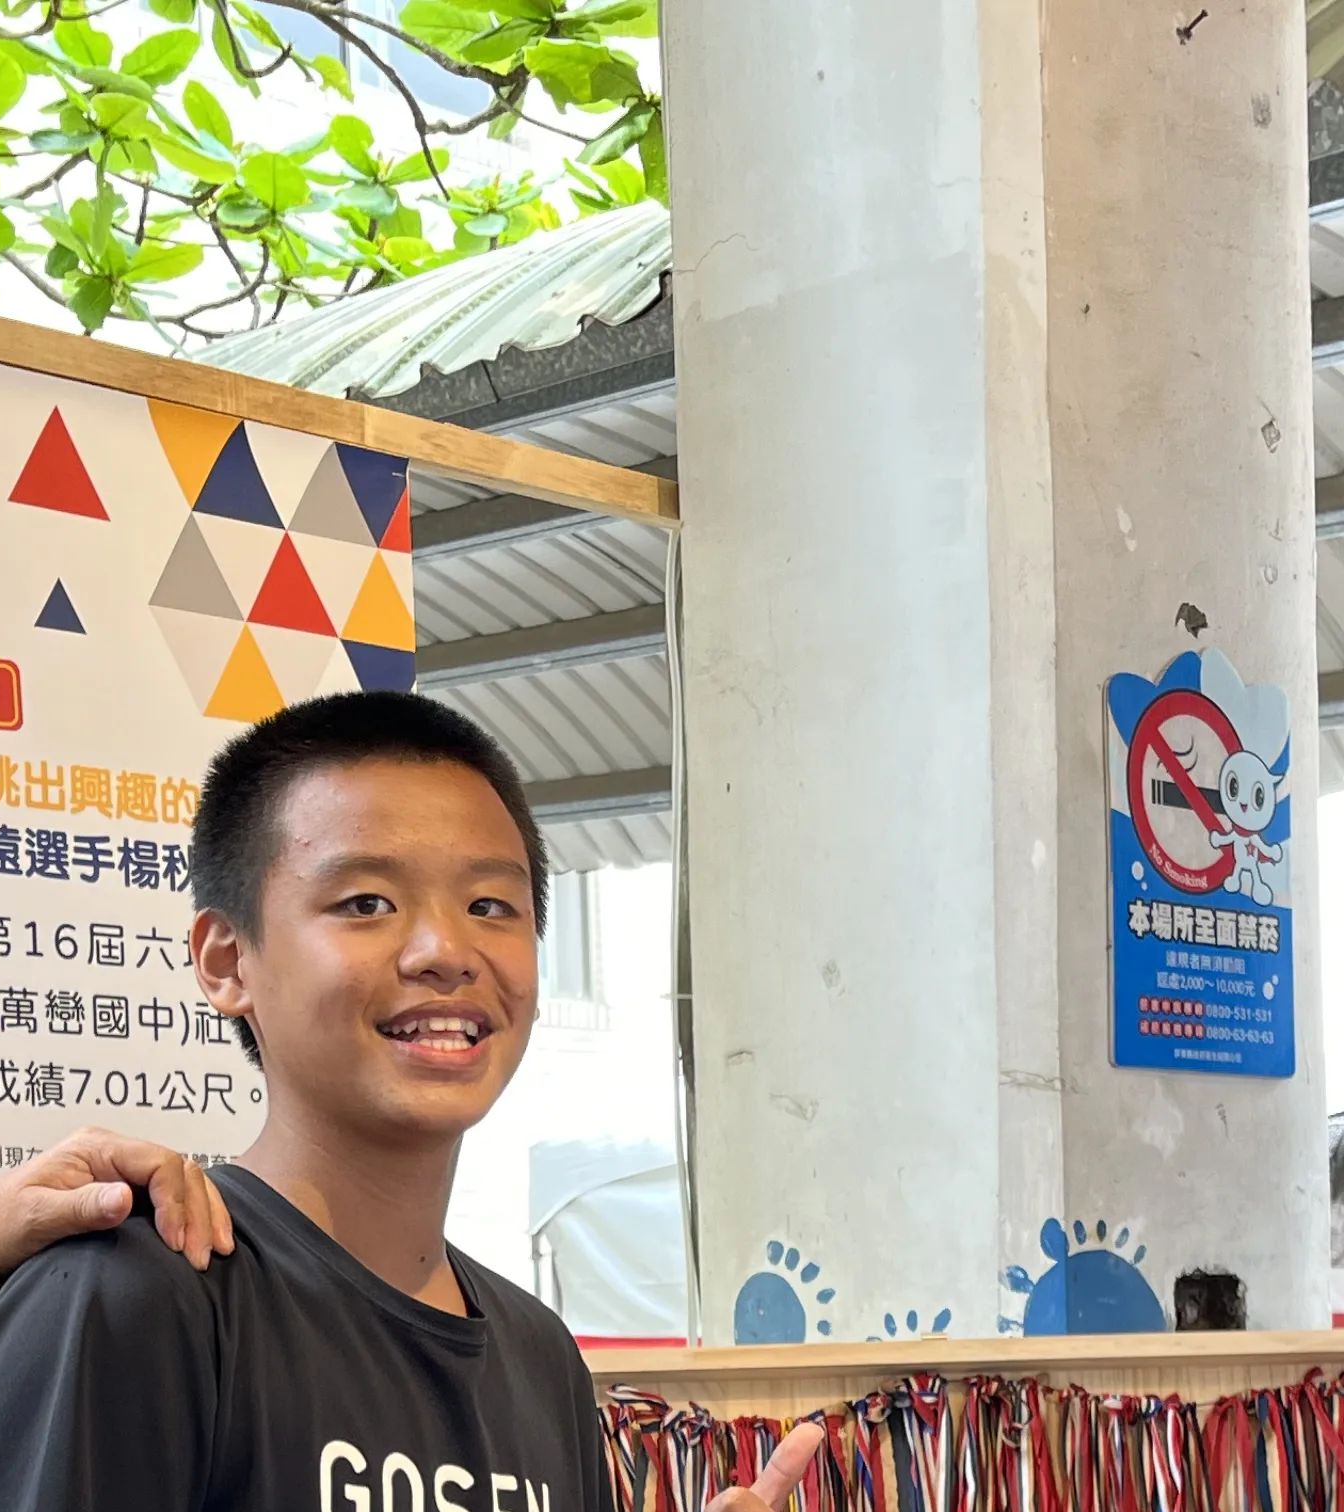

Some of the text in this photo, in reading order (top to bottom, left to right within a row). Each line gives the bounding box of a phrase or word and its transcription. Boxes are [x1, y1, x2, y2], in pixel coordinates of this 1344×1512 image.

[1129, 899, 1280, 953] 本場所全面禁菸
